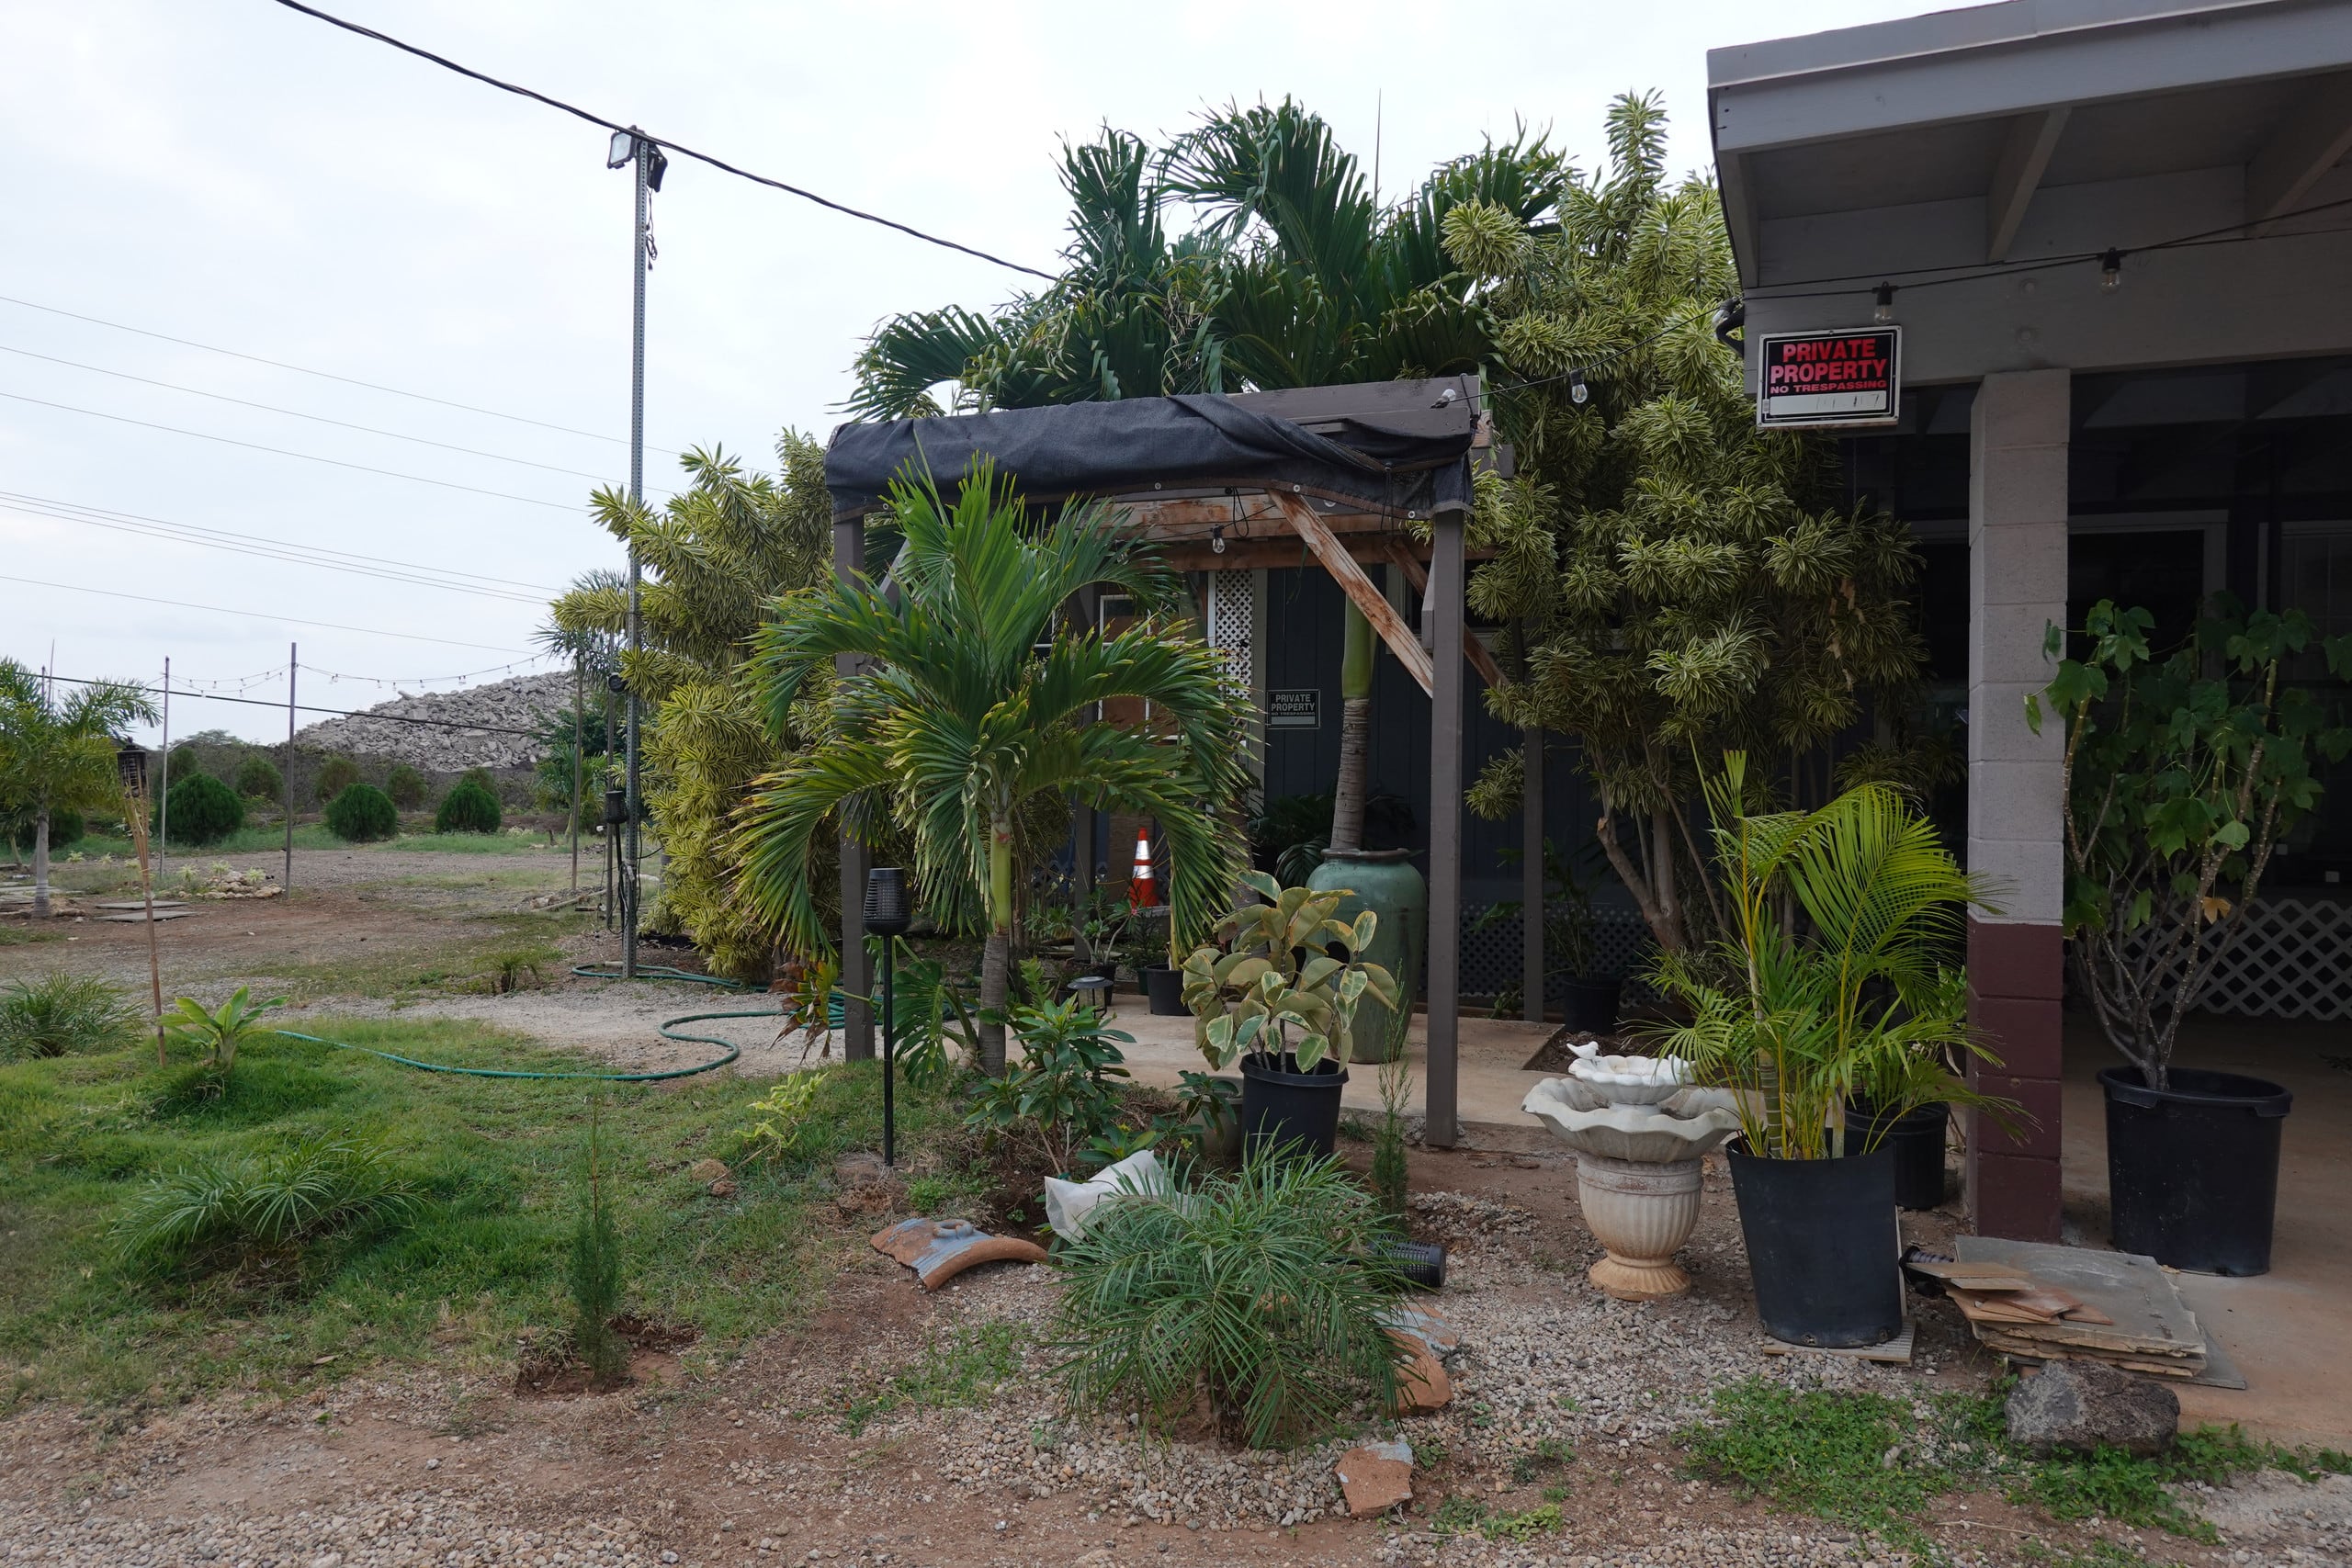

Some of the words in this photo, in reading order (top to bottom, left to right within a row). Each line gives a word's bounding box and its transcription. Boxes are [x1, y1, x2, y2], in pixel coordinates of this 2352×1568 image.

[1782, 338, 1876, 363] PRIVATE
[1770, 359, 1887, 384] PROPERTY
[1770, 385, 1789, 394] NO
[1793, 380, 1887, 393] TRESPASSING
[1275, 694, 1311, 703] PRIVATE
[1272, 703, 1315, 711] PROPERTY
